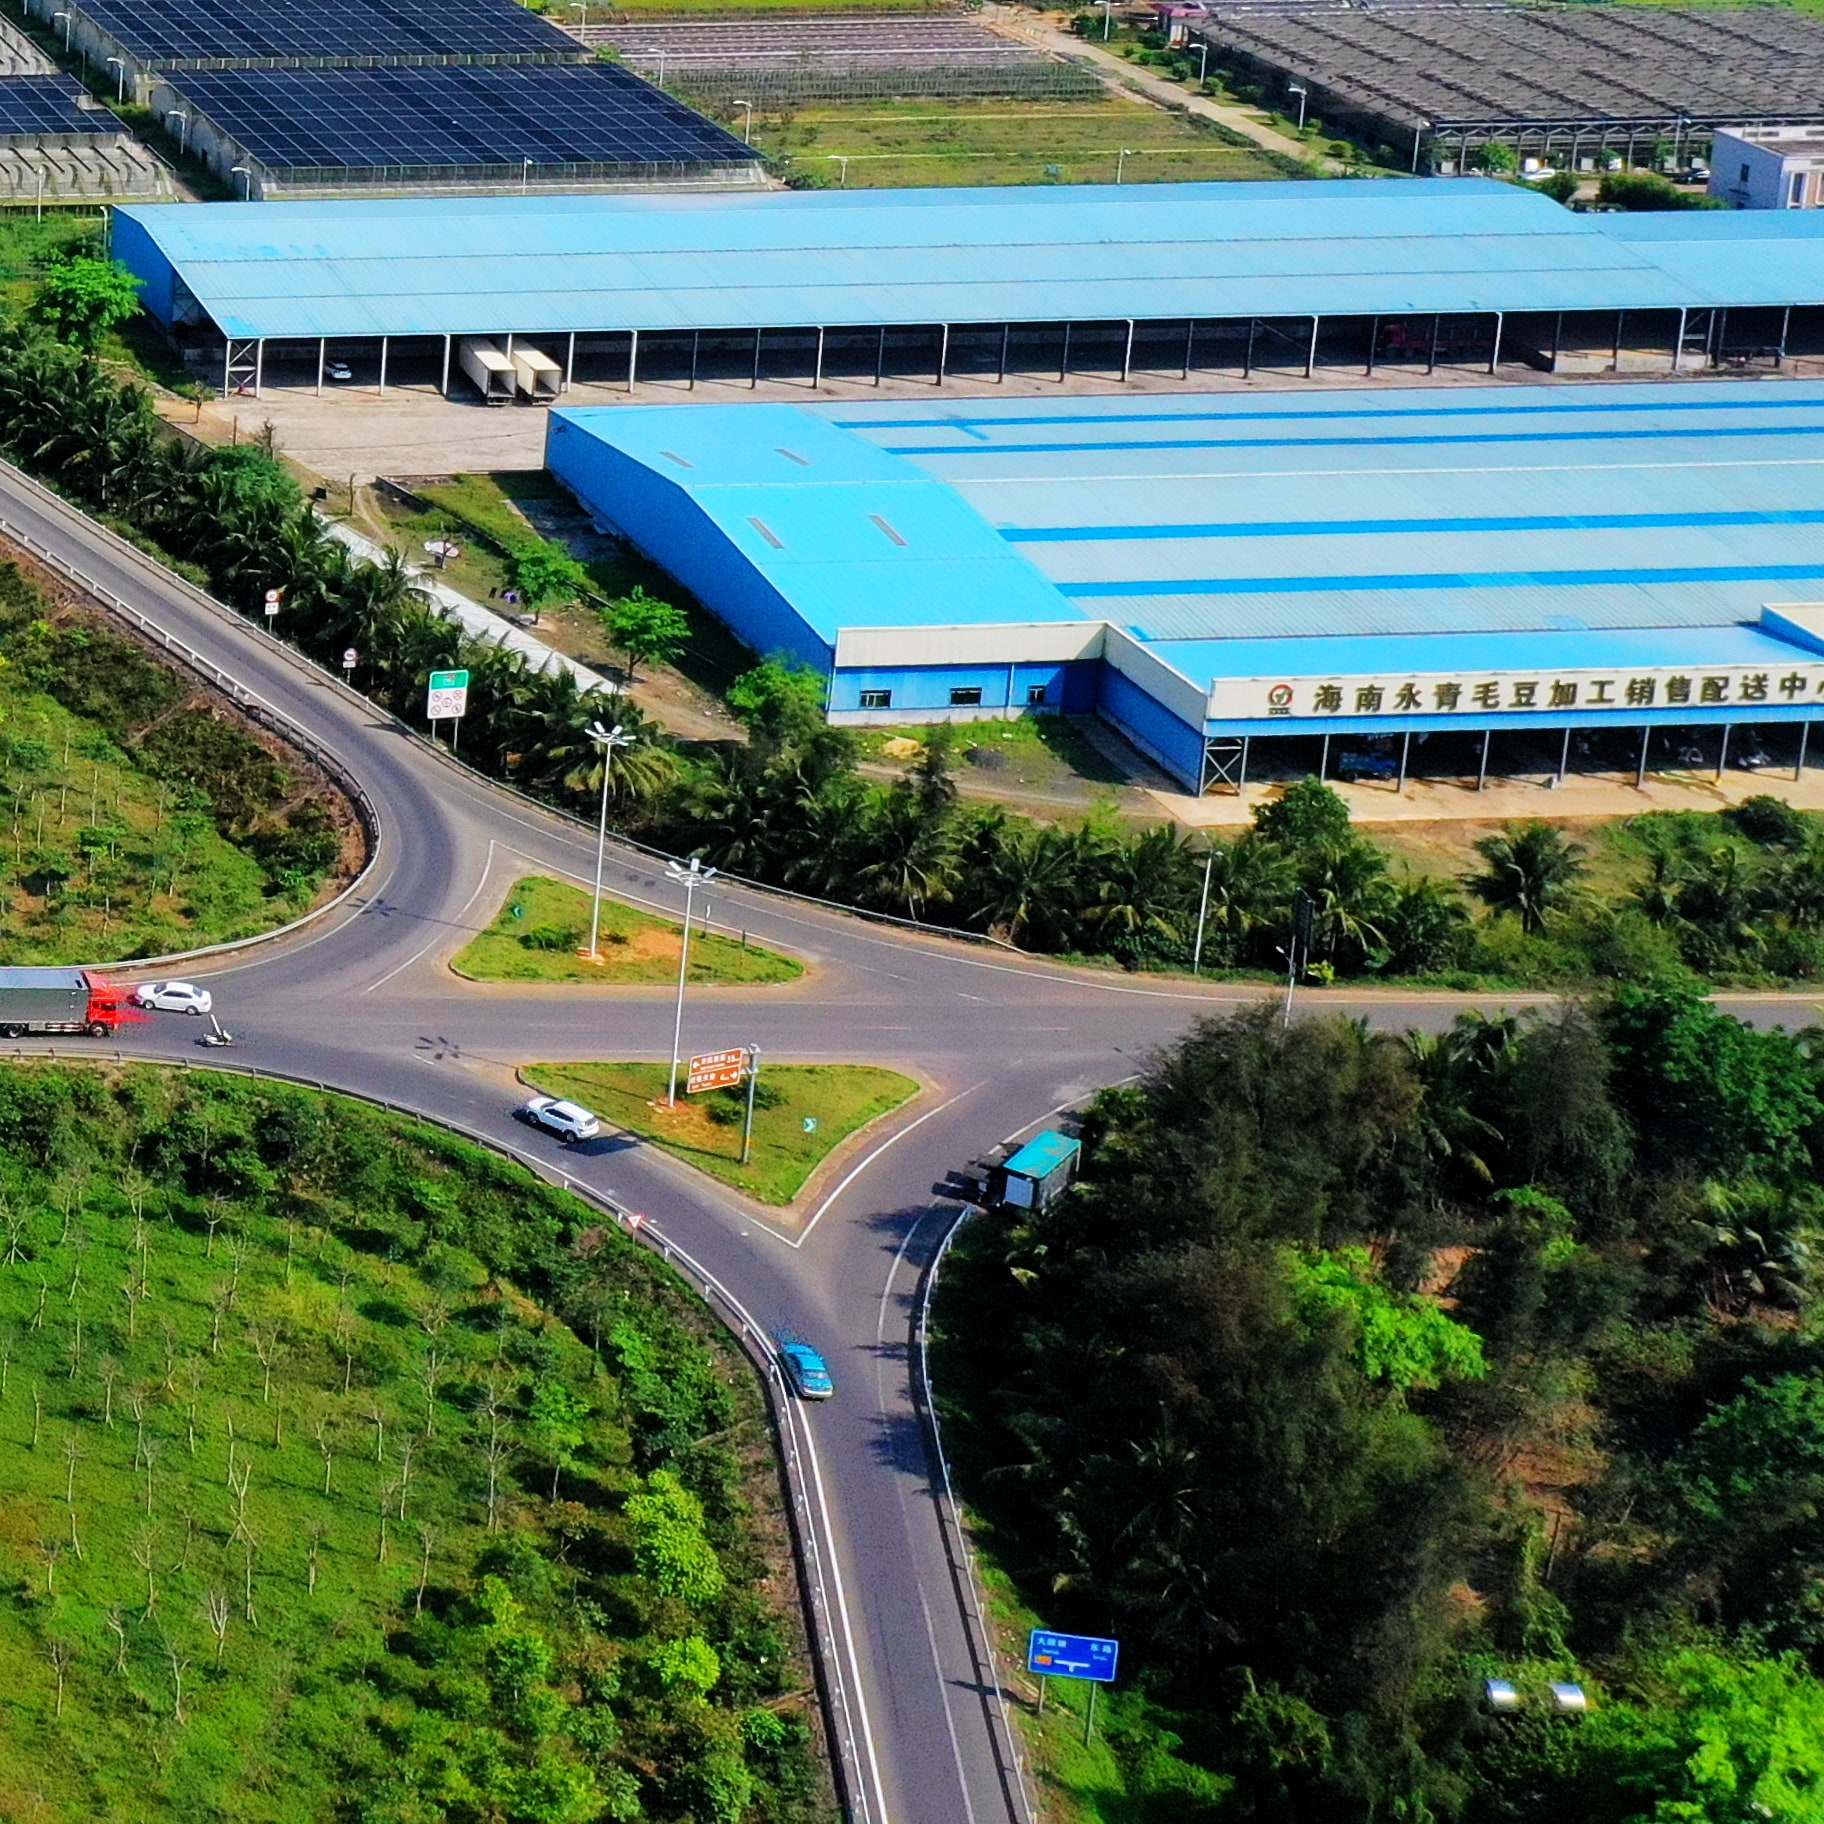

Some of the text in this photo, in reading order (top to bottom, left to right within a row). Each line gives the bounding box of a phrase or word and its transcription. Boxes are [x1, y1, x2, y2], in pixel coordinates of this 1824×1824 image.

[1314, 672, 1824, 713] 海南永青毛豆加工销售配送中
